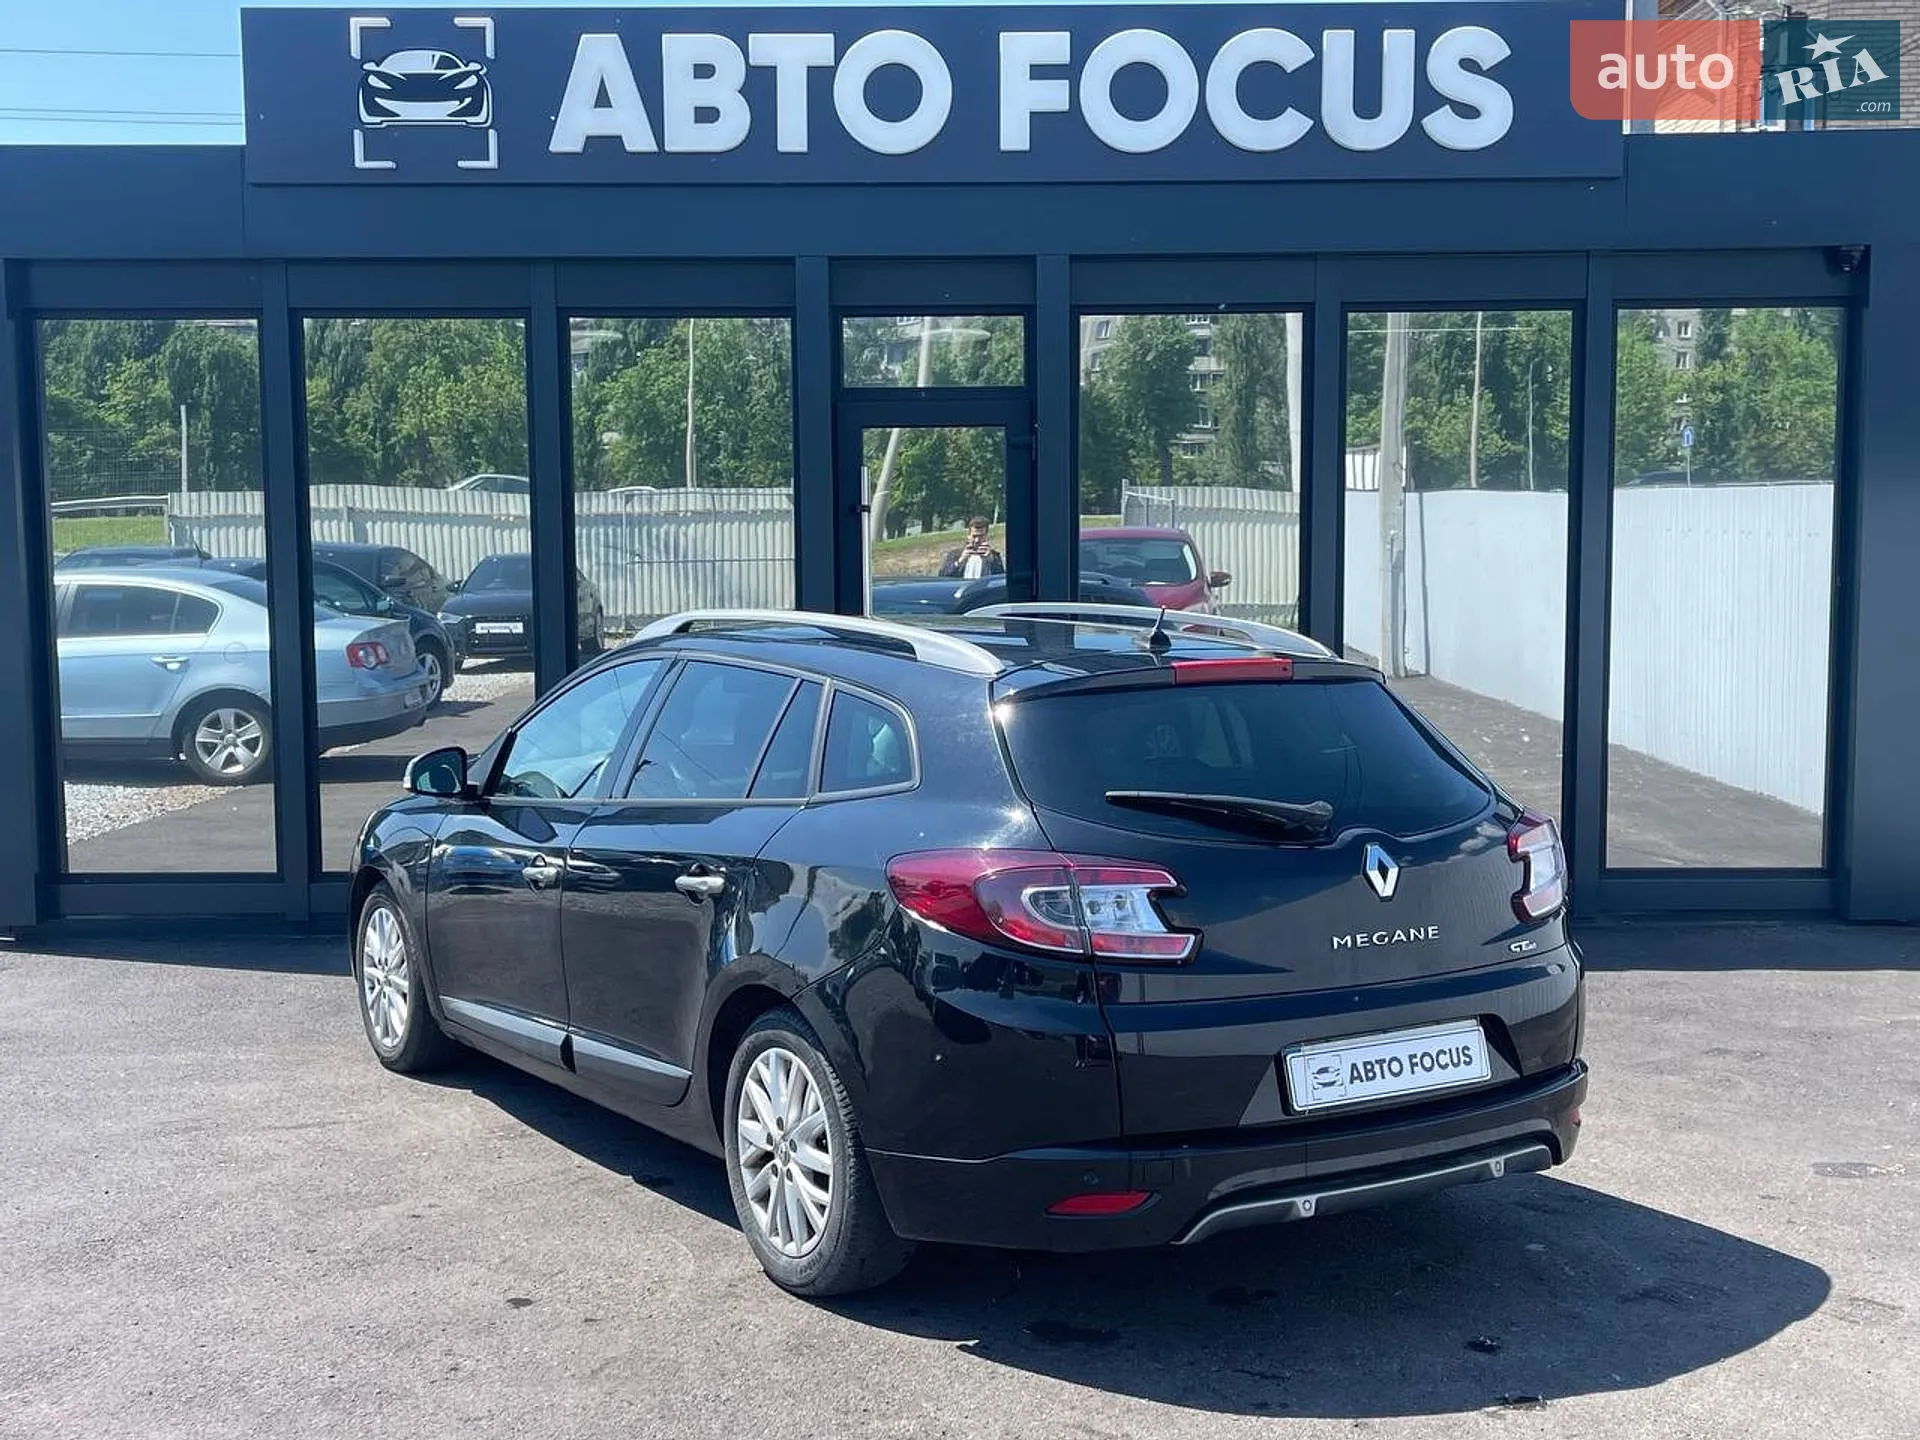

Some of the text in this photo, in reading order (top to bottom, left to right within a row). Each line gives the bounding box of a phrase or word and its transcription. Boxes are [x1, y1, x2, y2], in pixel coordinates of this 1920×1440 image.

[549, 26, 1514, 155] АВТО FOCUS
[1332, 925, 1440, 950] MEGANE
[1349, 1045, 1473, 1084] АВТО FOCUS
